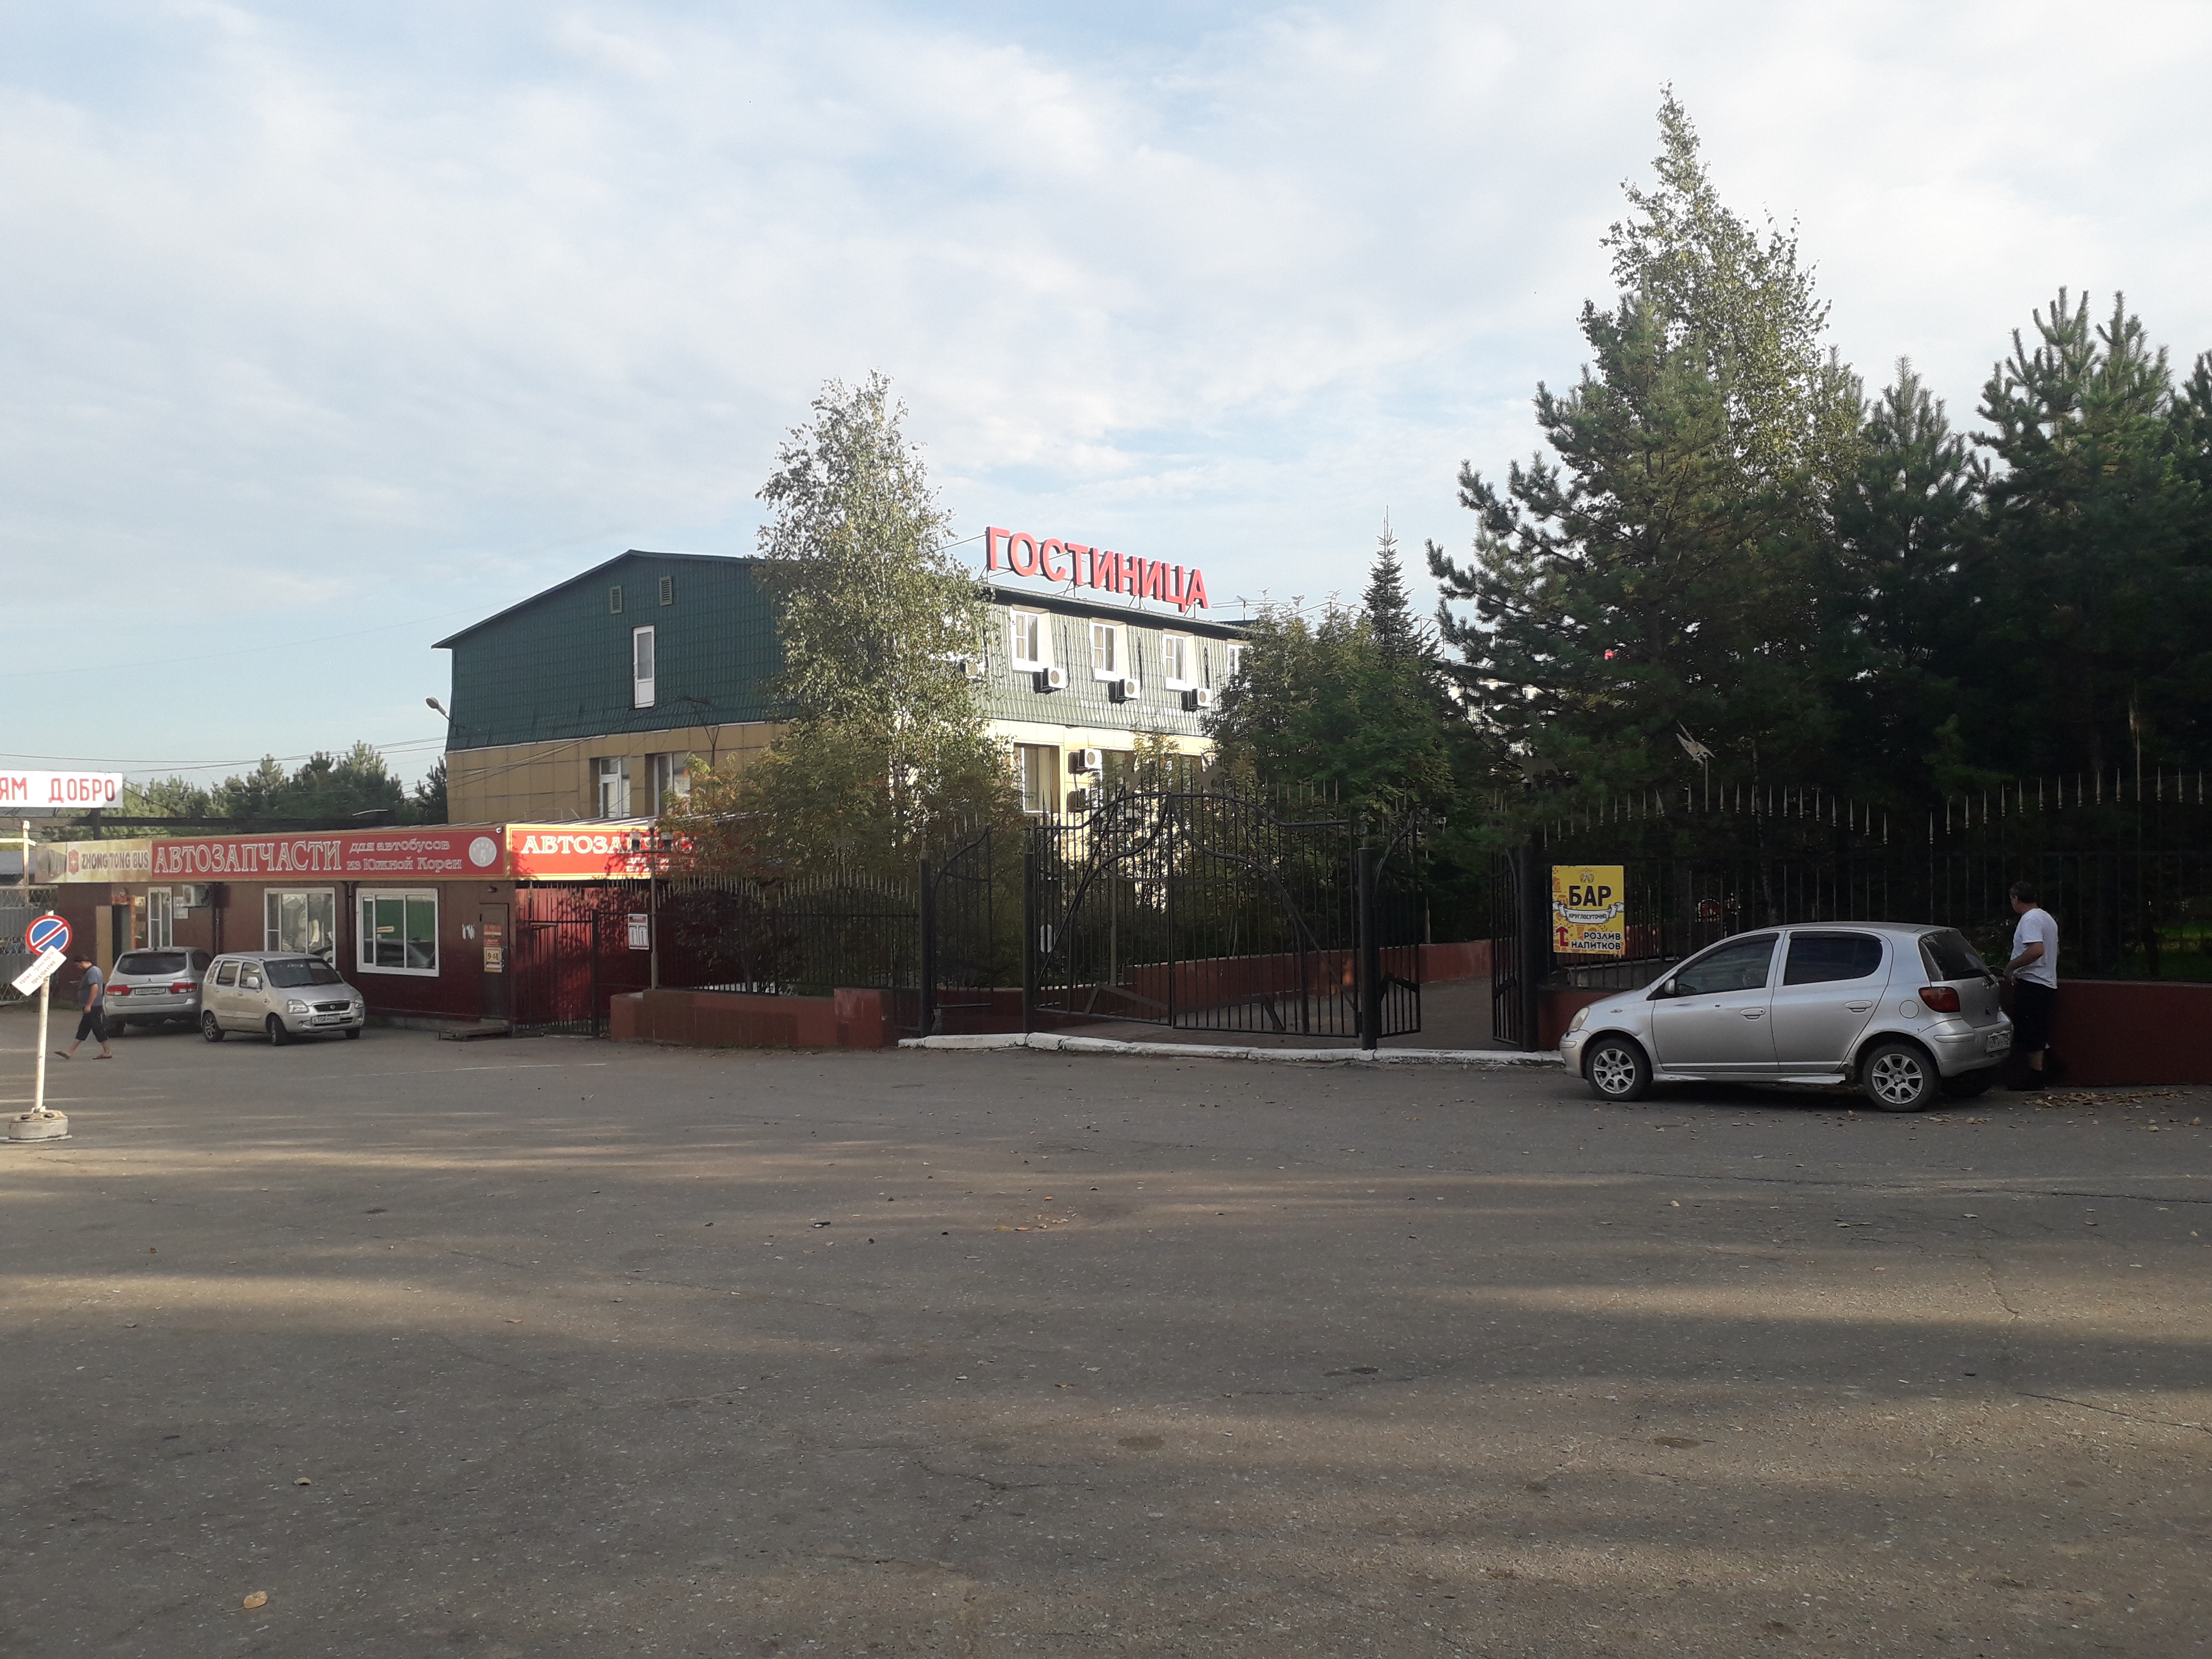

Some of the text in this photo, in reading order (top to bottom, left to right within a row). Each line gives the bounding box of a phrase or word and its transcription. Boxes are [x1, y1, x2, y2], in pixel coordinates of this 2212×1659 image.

[986, 526, 1209, 612] ГОСТИНИЦА
[48, 778, 115, 803] ДОБРО
[349, 838, 450, 854] для автобусов
[81, 850, 150, 870] ZHONG TONG BUS
[154, 840, 341, 873] АВТОЗАПЧАСТИ
[347, 856, 462, 873] из Южной Кореи
[1569, 885, 1611, 906] БАР
[1571, 941, 1621, 950] НАПИТКОВ
[1584, 932, 1621, 940] РОЗЛИВ
